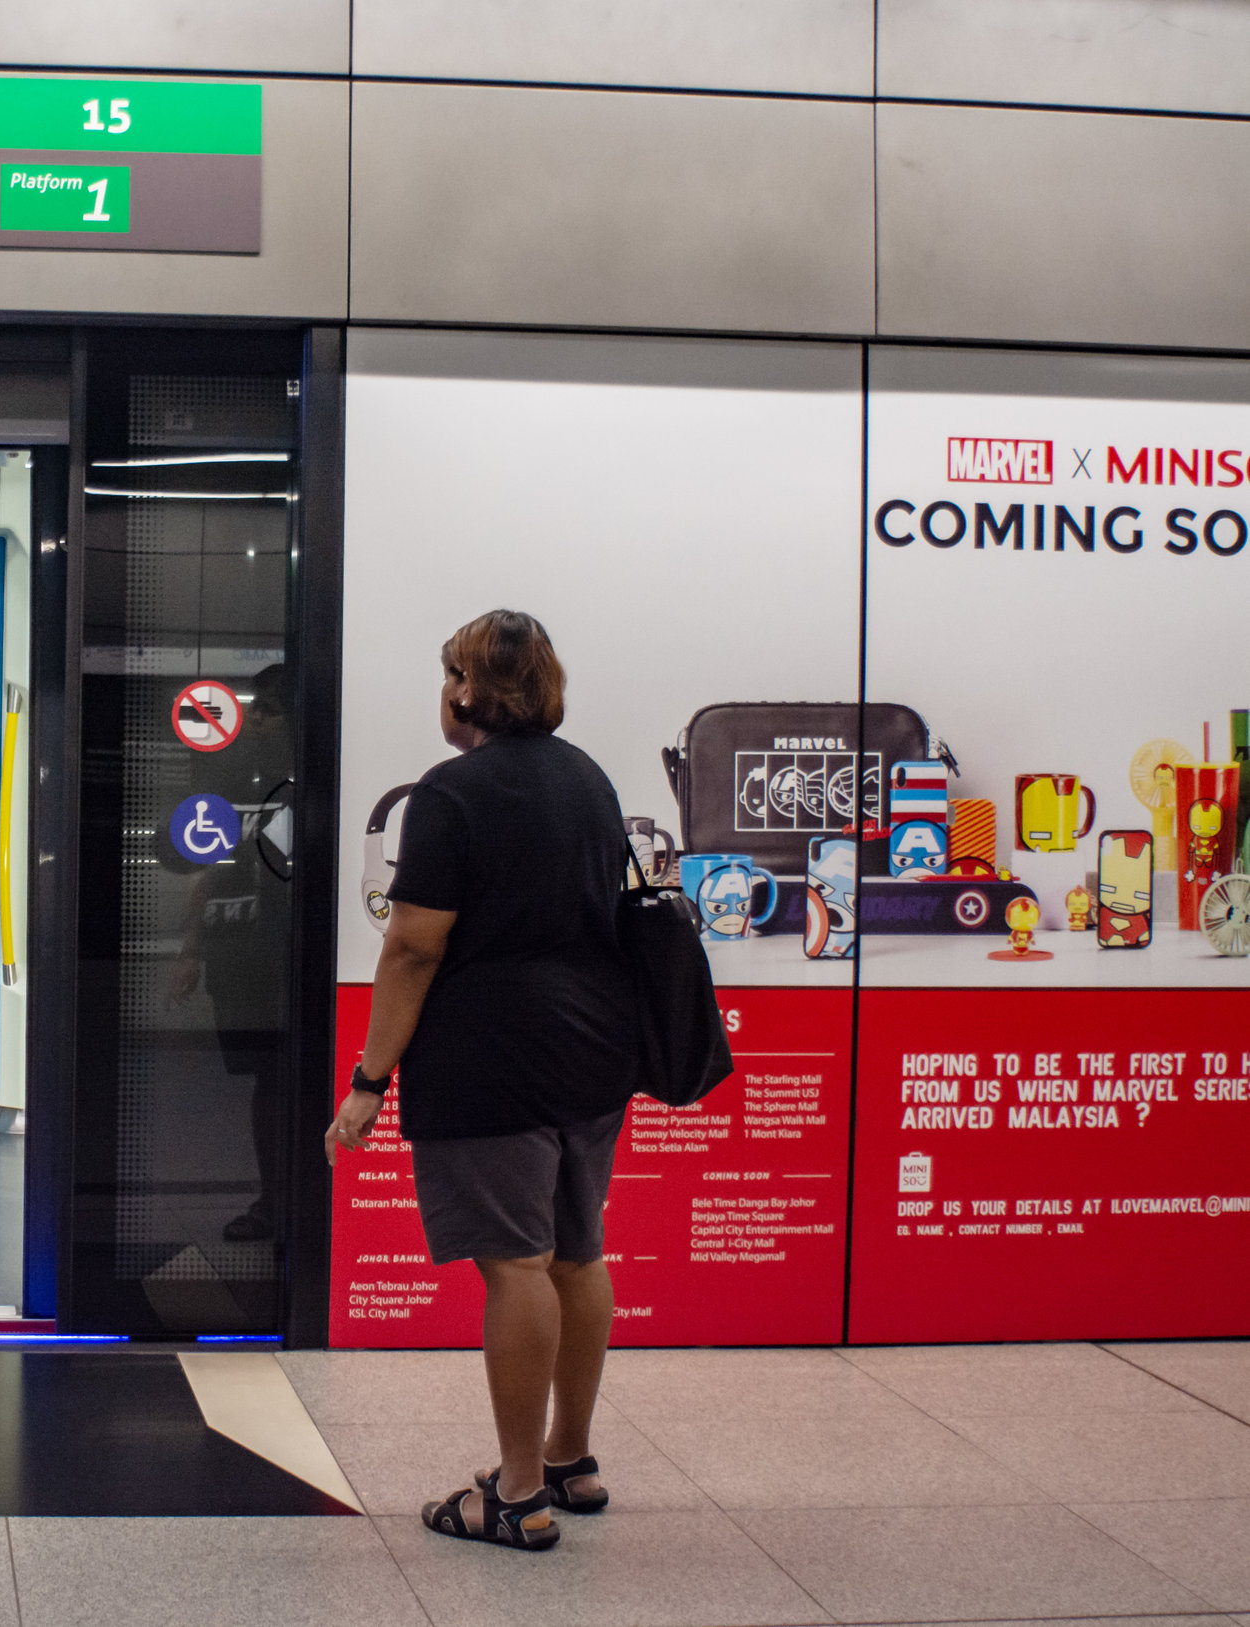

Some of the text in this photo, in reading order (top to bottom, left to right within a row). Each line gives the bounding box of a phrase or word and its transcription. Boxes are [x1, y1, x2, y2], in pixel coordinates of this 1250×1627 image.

[82, 99, 132, 134] 15
[10, 172, 84, 194] Platform
[82, 178, 113, 222] 1
[950, 440, 1051, 482] MARVEL
[1106, 445, 1250, 488] MINIS
[874, 499, 1144, 554] COMING
[901, 1054, 978, 1076] HOPING
[993, 1054, 1020, 1076] TO
[1034, 1054, 1062, 1076] BE
[1077, 1053, 1115, 1076] THE
[1129, 1053, 1186, 1075] FIRST
[1201, 1053, 1227, 1075] TO
[745, 1074, 822, 1086] The Starling Mall
[745, 1088, 819, 1098] The Summit USJ
[901, 1079, 1250, 1102] FROM US WHEN MARVEL SERIE
[632, 1101, 668, 1113] Subang
[744, 1102, 818, 1114] The Sphere Mall
[632, 1115, 730, 1127] Sunway Pyramid Mall
[744, 1115, 825, 1127] Wangsa Walk Mall
[901, 1103, 1150, 1129] ARRIVED MALAYSIA ?
[367, 1128, 397, 1138] heras
[631, 1129, 728, 1140] Sunway Velocity Mall
[744, 1129, 801, 1138] 1 Mont Kiara
[631, 1142, 708, 1152] Tesco Setia Alam
[903, 1165, 927, 1174] MINI
[358, 1172, 398, 1180] MELAKA
[702, 1172, 770, 1181] COMING SOON
[351, 1198, 390, 1208] Dataran
[692, 1198, 816, 1210] Bele Time Danga Bay Johor
[897, 1201, 933, 1216] DROP
[943, 1201, 961, 1216] US
[971, 1200, 1006, 1216] YOUR
[1015, 1200, 1072, 1215] DETAILS
[1082, 1199, 1102, 1215] AT
[691, 1211, 784, 1224] Berjaya Time Square
[691, 1224, 834, 1237] Capital City Entertainment Mall
[916, 1225, 944, 1235] NAME
[958, 1224, 1000, 1235] CONTACT
[1006, 1224, 1043, 1234] NUMBER
[1057, 1223, 1084, 1234] EMAIL
[690, 1238, 775, 1250] Central i-City Mall
[356, 1254, 425, 1263] JOHOR BAHRU
[690, 1252, 785, 1263] Mid Valley Megamall
[350, 1281, 438, 1291] Aeon Tebrau Johor
[349, 1295, 433, 1306] City Square Johor
[349, 1308, 410, 1320] KSL City Mall
[631, 1306, 652, 1317] Mall
